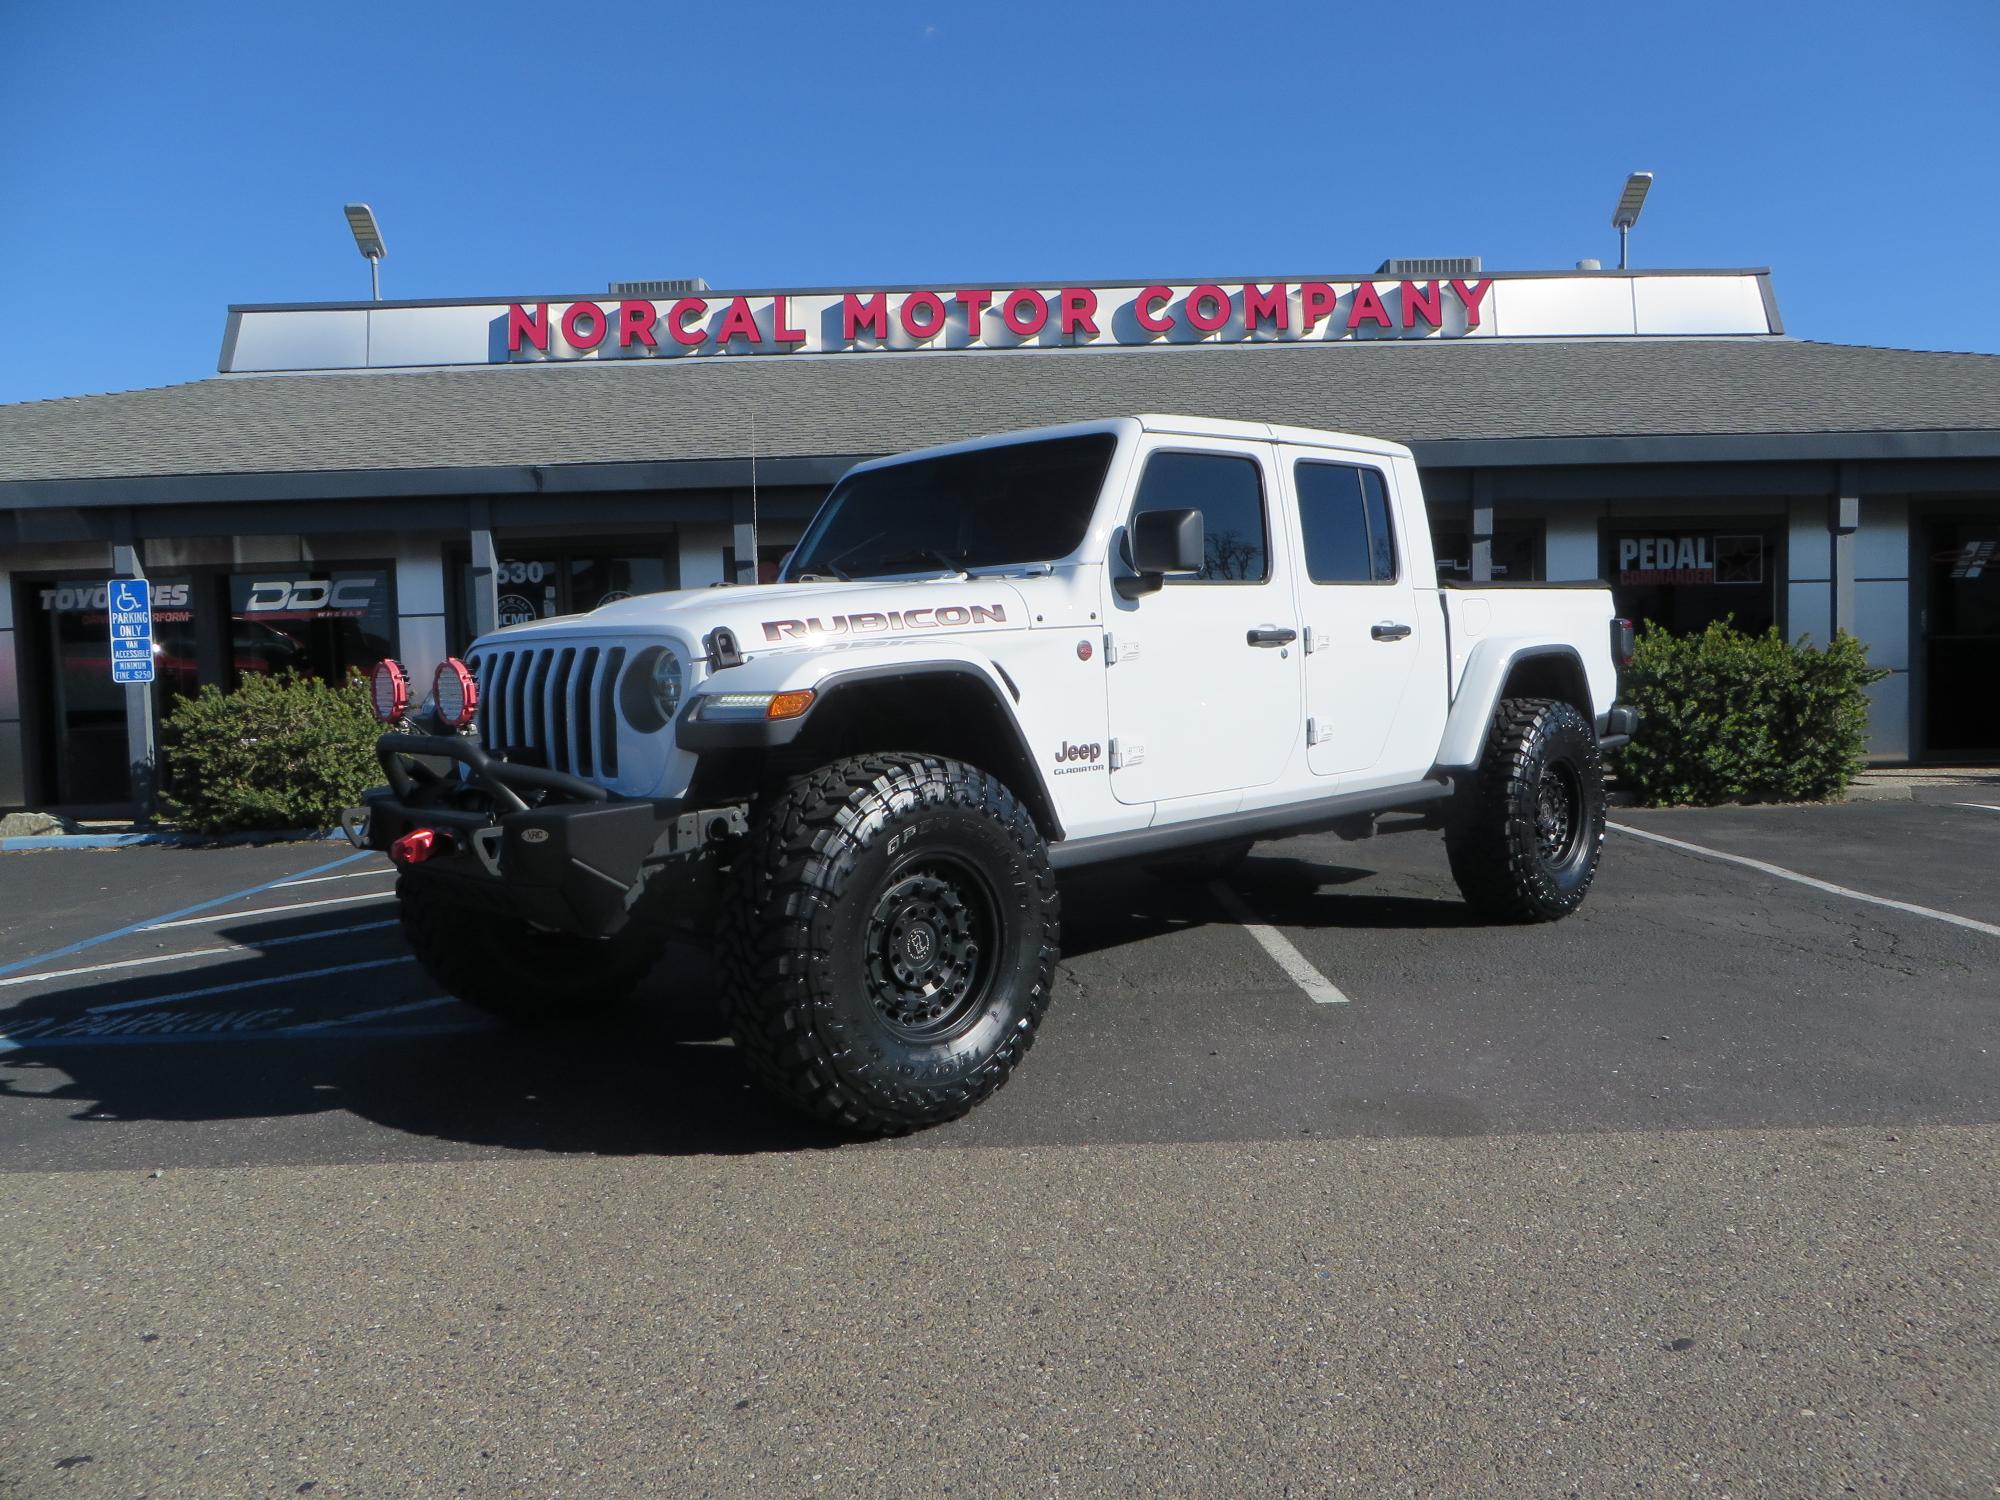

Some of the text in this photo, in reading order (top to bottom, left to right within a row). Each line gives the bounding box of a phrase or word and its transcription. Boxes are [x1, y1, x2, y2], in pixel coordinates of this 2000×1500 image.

[508, 278, 1493, 352] NORCAL MOTOR COMPANY
[1619, 537, 1713, 570] PEDAL
[1620, 570, 1713, 585] COMMANDER
[246, 579, 377, 611] DDC
[112, 611, 148, 624] PARKING
[761, 604, 1007, 642] RUBICON
[120, 625, 142, 637] ONLY
[125, 641, 139, 649] VAN
[115, 650, 150, 658] ACCESSIBLE
[119, 662, 147, 670] MINIMUM
[116, 671, 151, 680] FINE $250
[1054, 741, 1101, 763] Jeep
[1053, 764, 1105, 776] GLADIATOR
